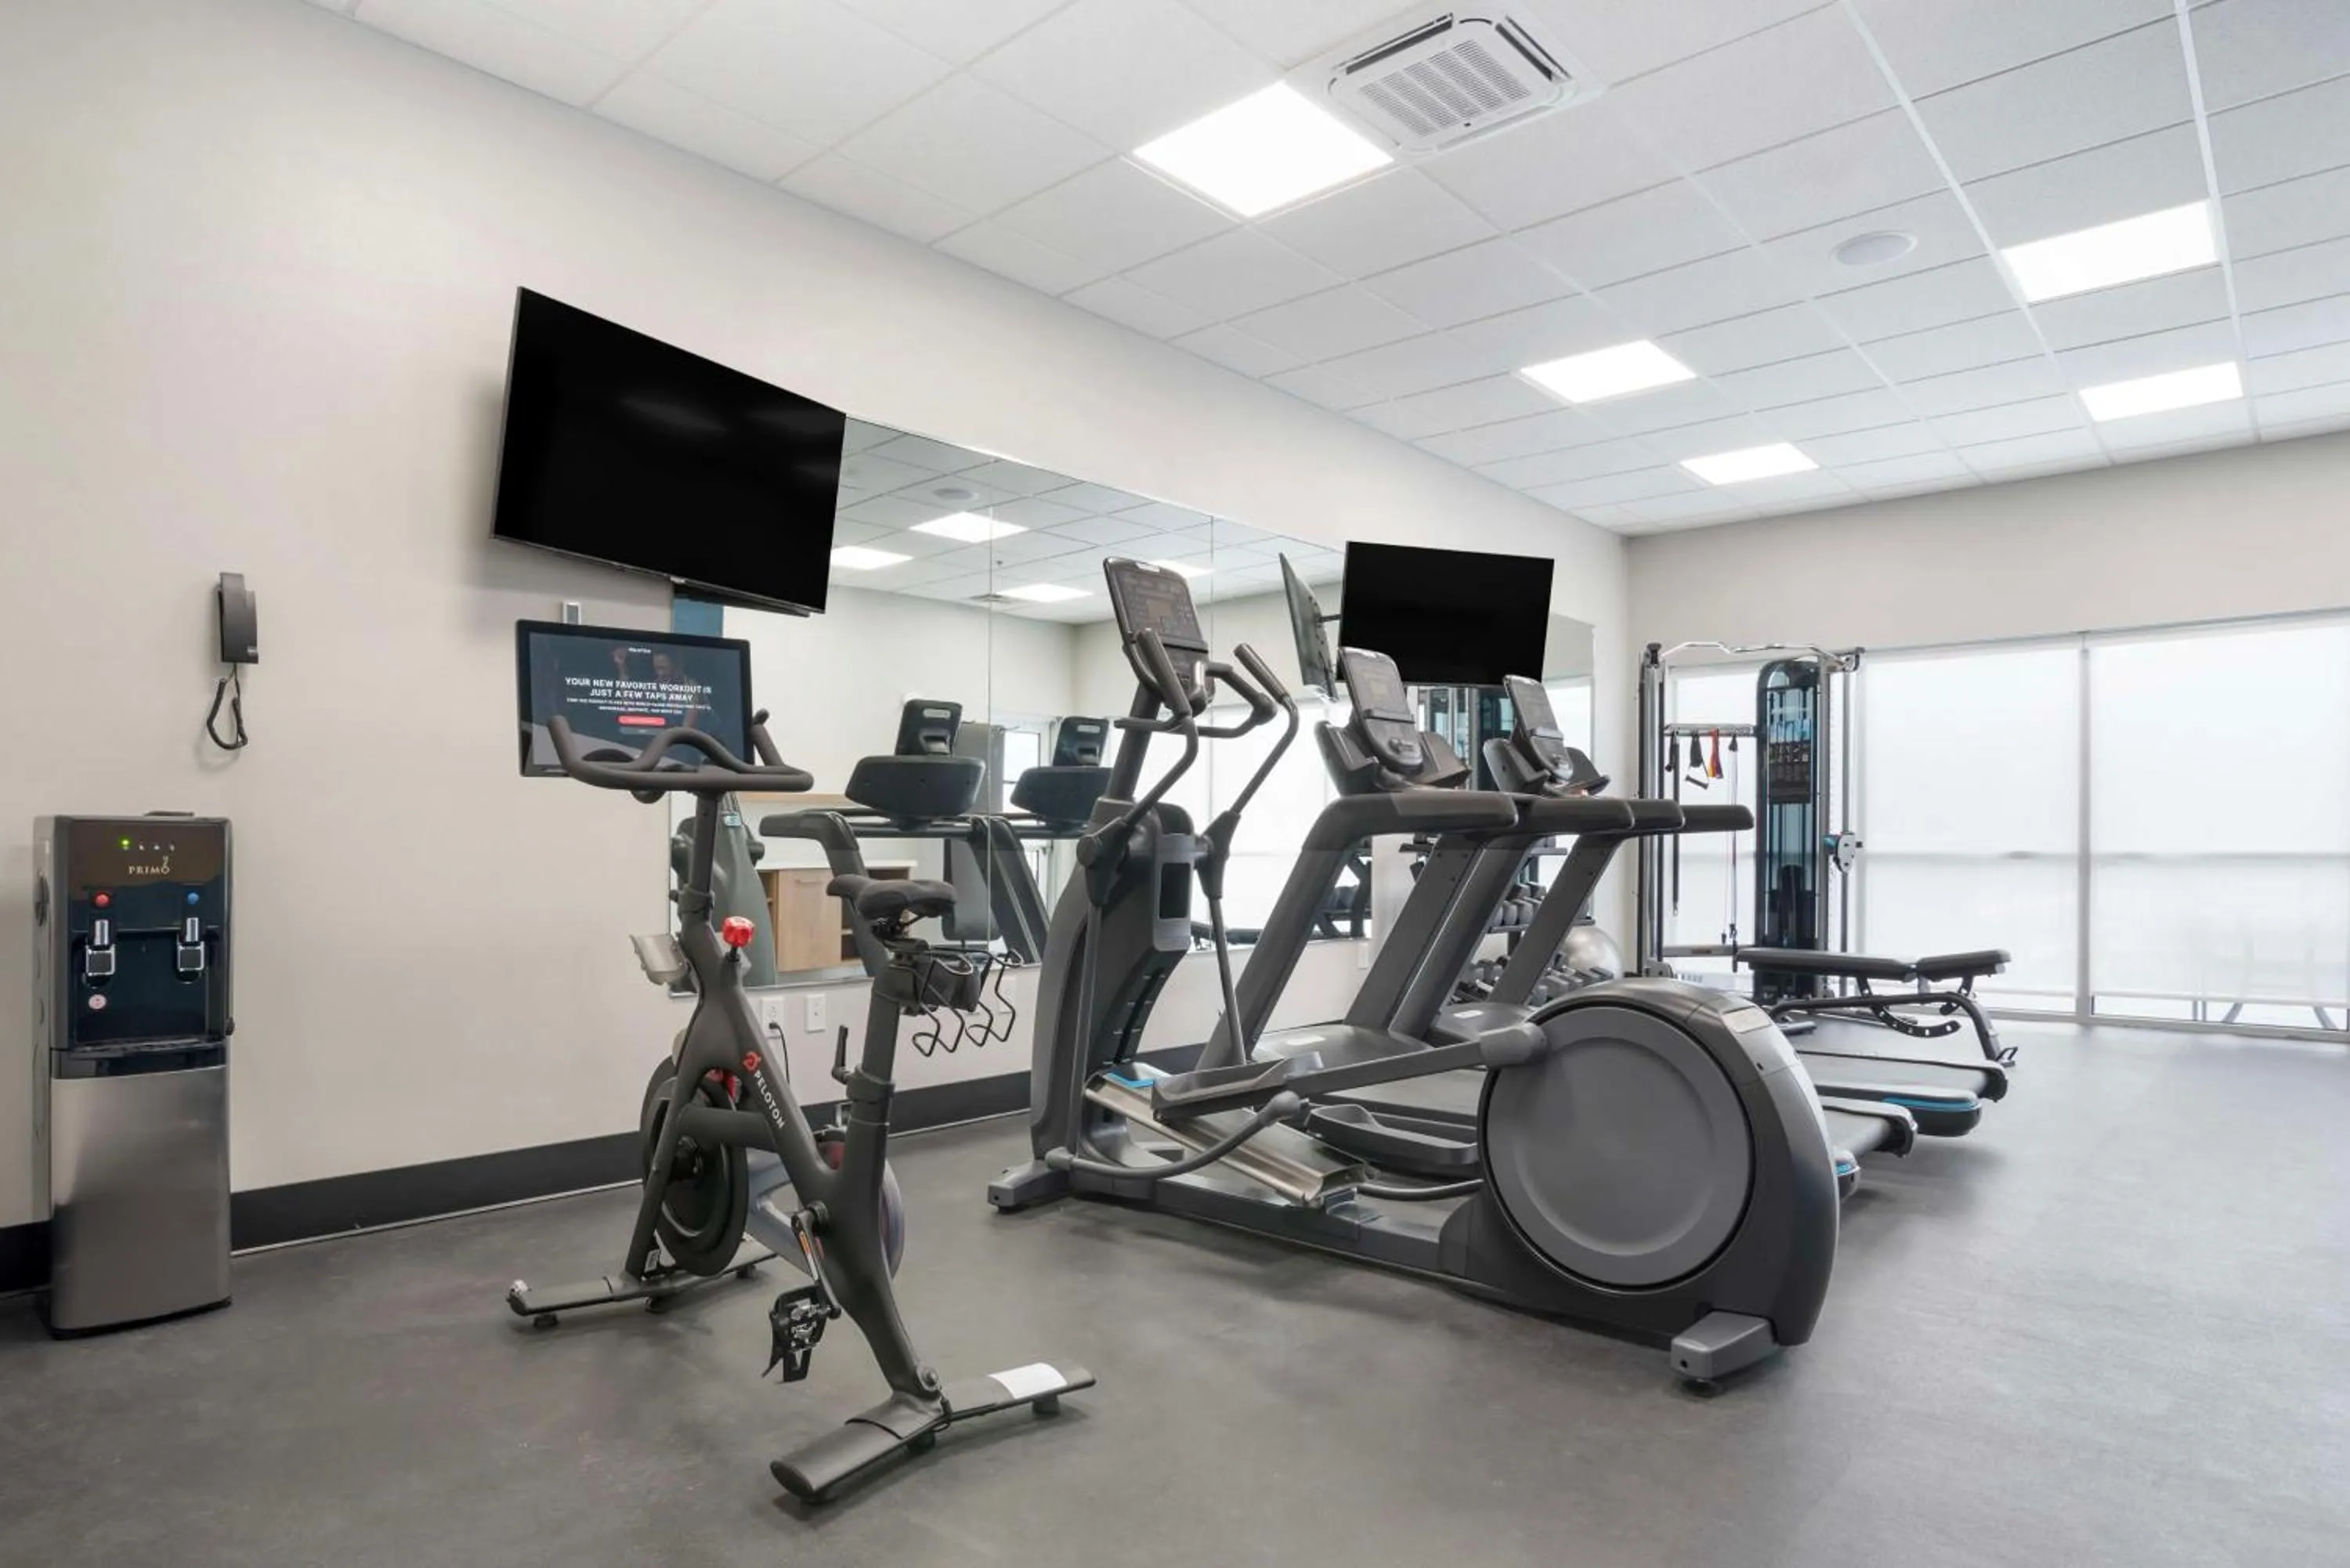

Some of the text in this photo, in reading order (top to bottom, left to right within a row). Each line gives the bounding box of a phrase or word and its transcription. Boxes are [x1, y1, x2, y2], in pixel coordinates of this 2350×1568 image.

[565, 677, 591, 686] YOUR
[593, 679, 613, 688] NEW
[616, 680, 656, 691] FAVORITE
[660, 683, 702, 693] WORKOUT
[645, 692, 667, 700] TAPS
[128, 865, 170, 875] PRIMO
[754, 1070, 785, 1129] PELOTON
